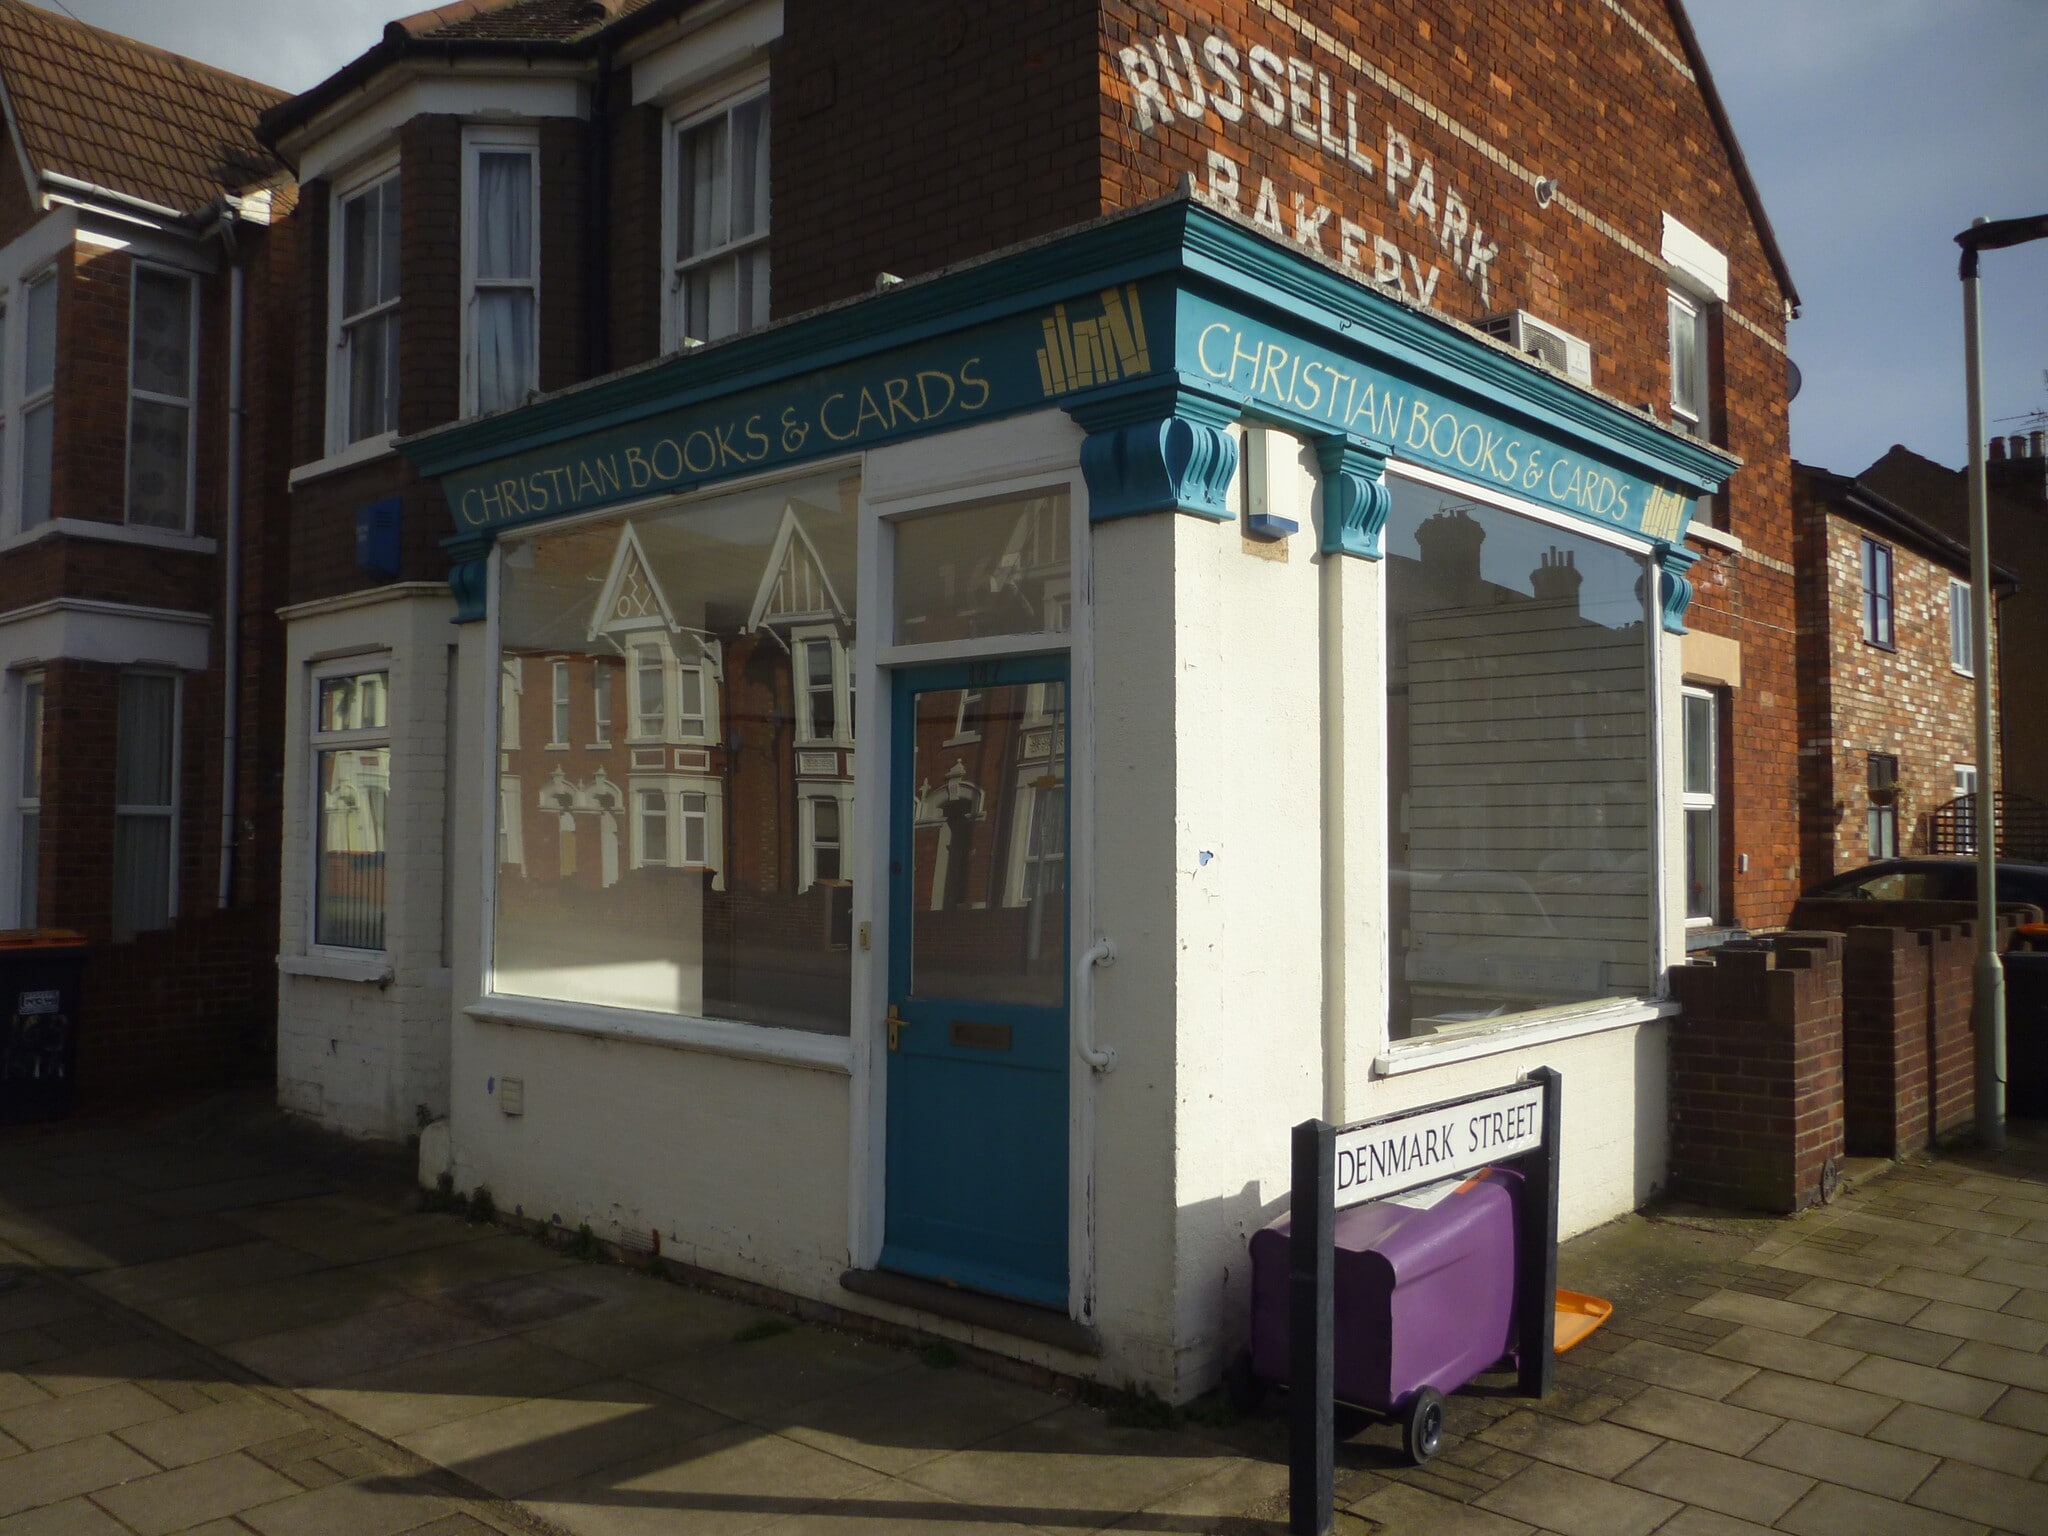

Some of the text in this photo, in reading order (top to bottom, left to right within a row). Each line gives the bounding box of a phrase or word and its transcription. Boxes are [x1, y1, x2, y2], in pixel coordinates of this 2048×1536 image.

[1119, 34, 1498, 308] RUSSELL PARK
[461, 357, 991, 526] CHRISTIAN BOOKS & CARDS
[1198, 323, 1631, 520] CHRISTIAN BOOKS & CARDS
[1338, 1123, 1456, 1190] DENMARK
[1469, 1102, 1538, 1153] STREET
